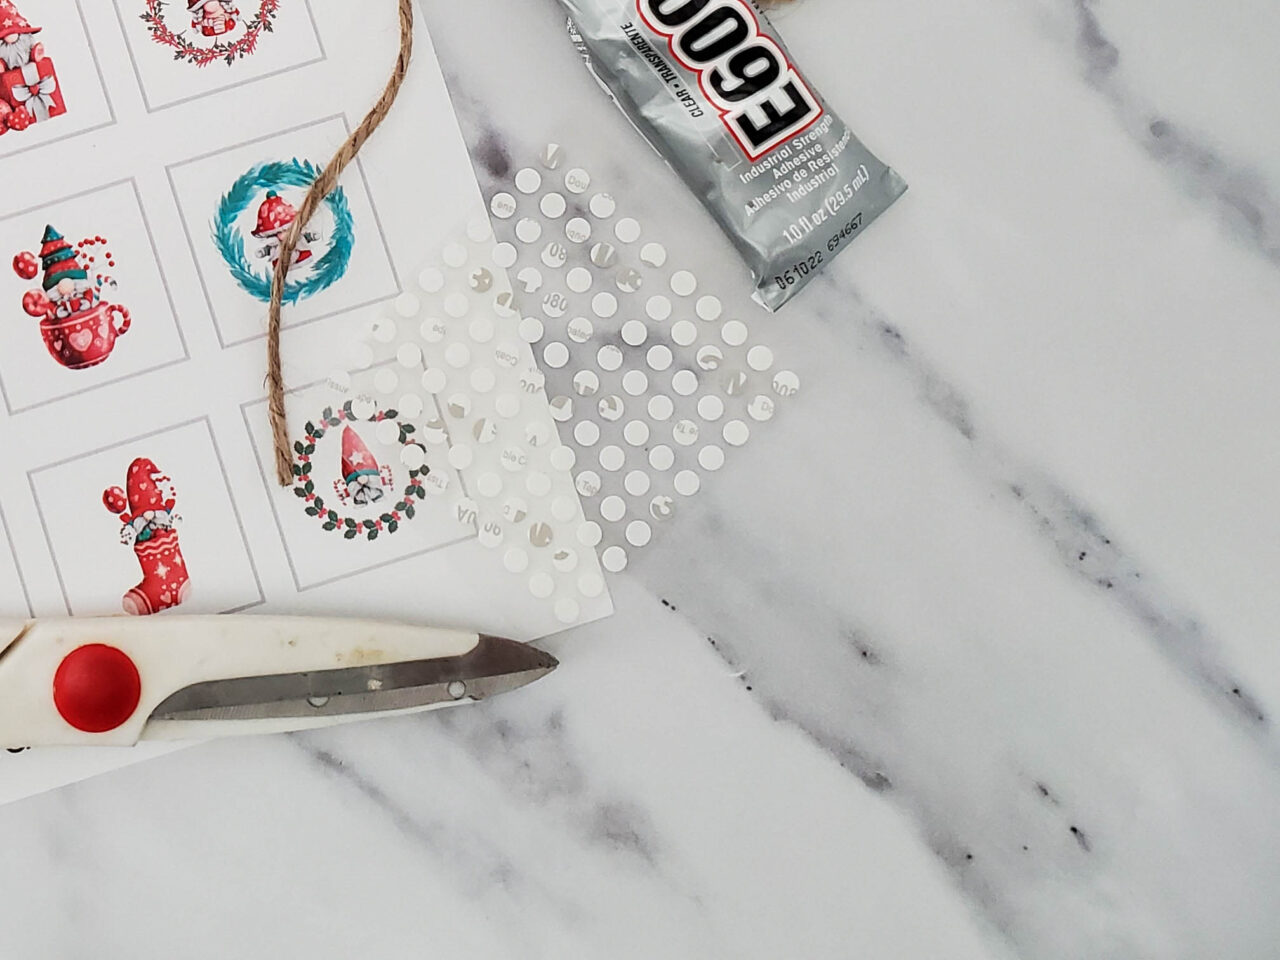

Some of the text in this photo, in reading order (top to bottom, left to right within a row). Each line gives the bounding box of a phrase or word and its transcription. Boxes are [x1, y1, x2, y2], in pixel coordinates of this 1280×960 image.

[620, 22, 704, 118] CLEAR TRANSPARENTE
[739, 114, 833, 184] Industrial Strength
[772, 142, 823, 180] Adhesive
[786, 162, 840, 204] Industrial
[744, 178, 792, 217] Adhesivo
[793, 167, 808, 183] de
[798, 214, 814, 234] fl
[812, 208, 829, 226] oz
[824, 183, 854, 216] (29.5
[851, 164, 869, 192] mL)
[774, 212, 863, 290] 061022 694667
